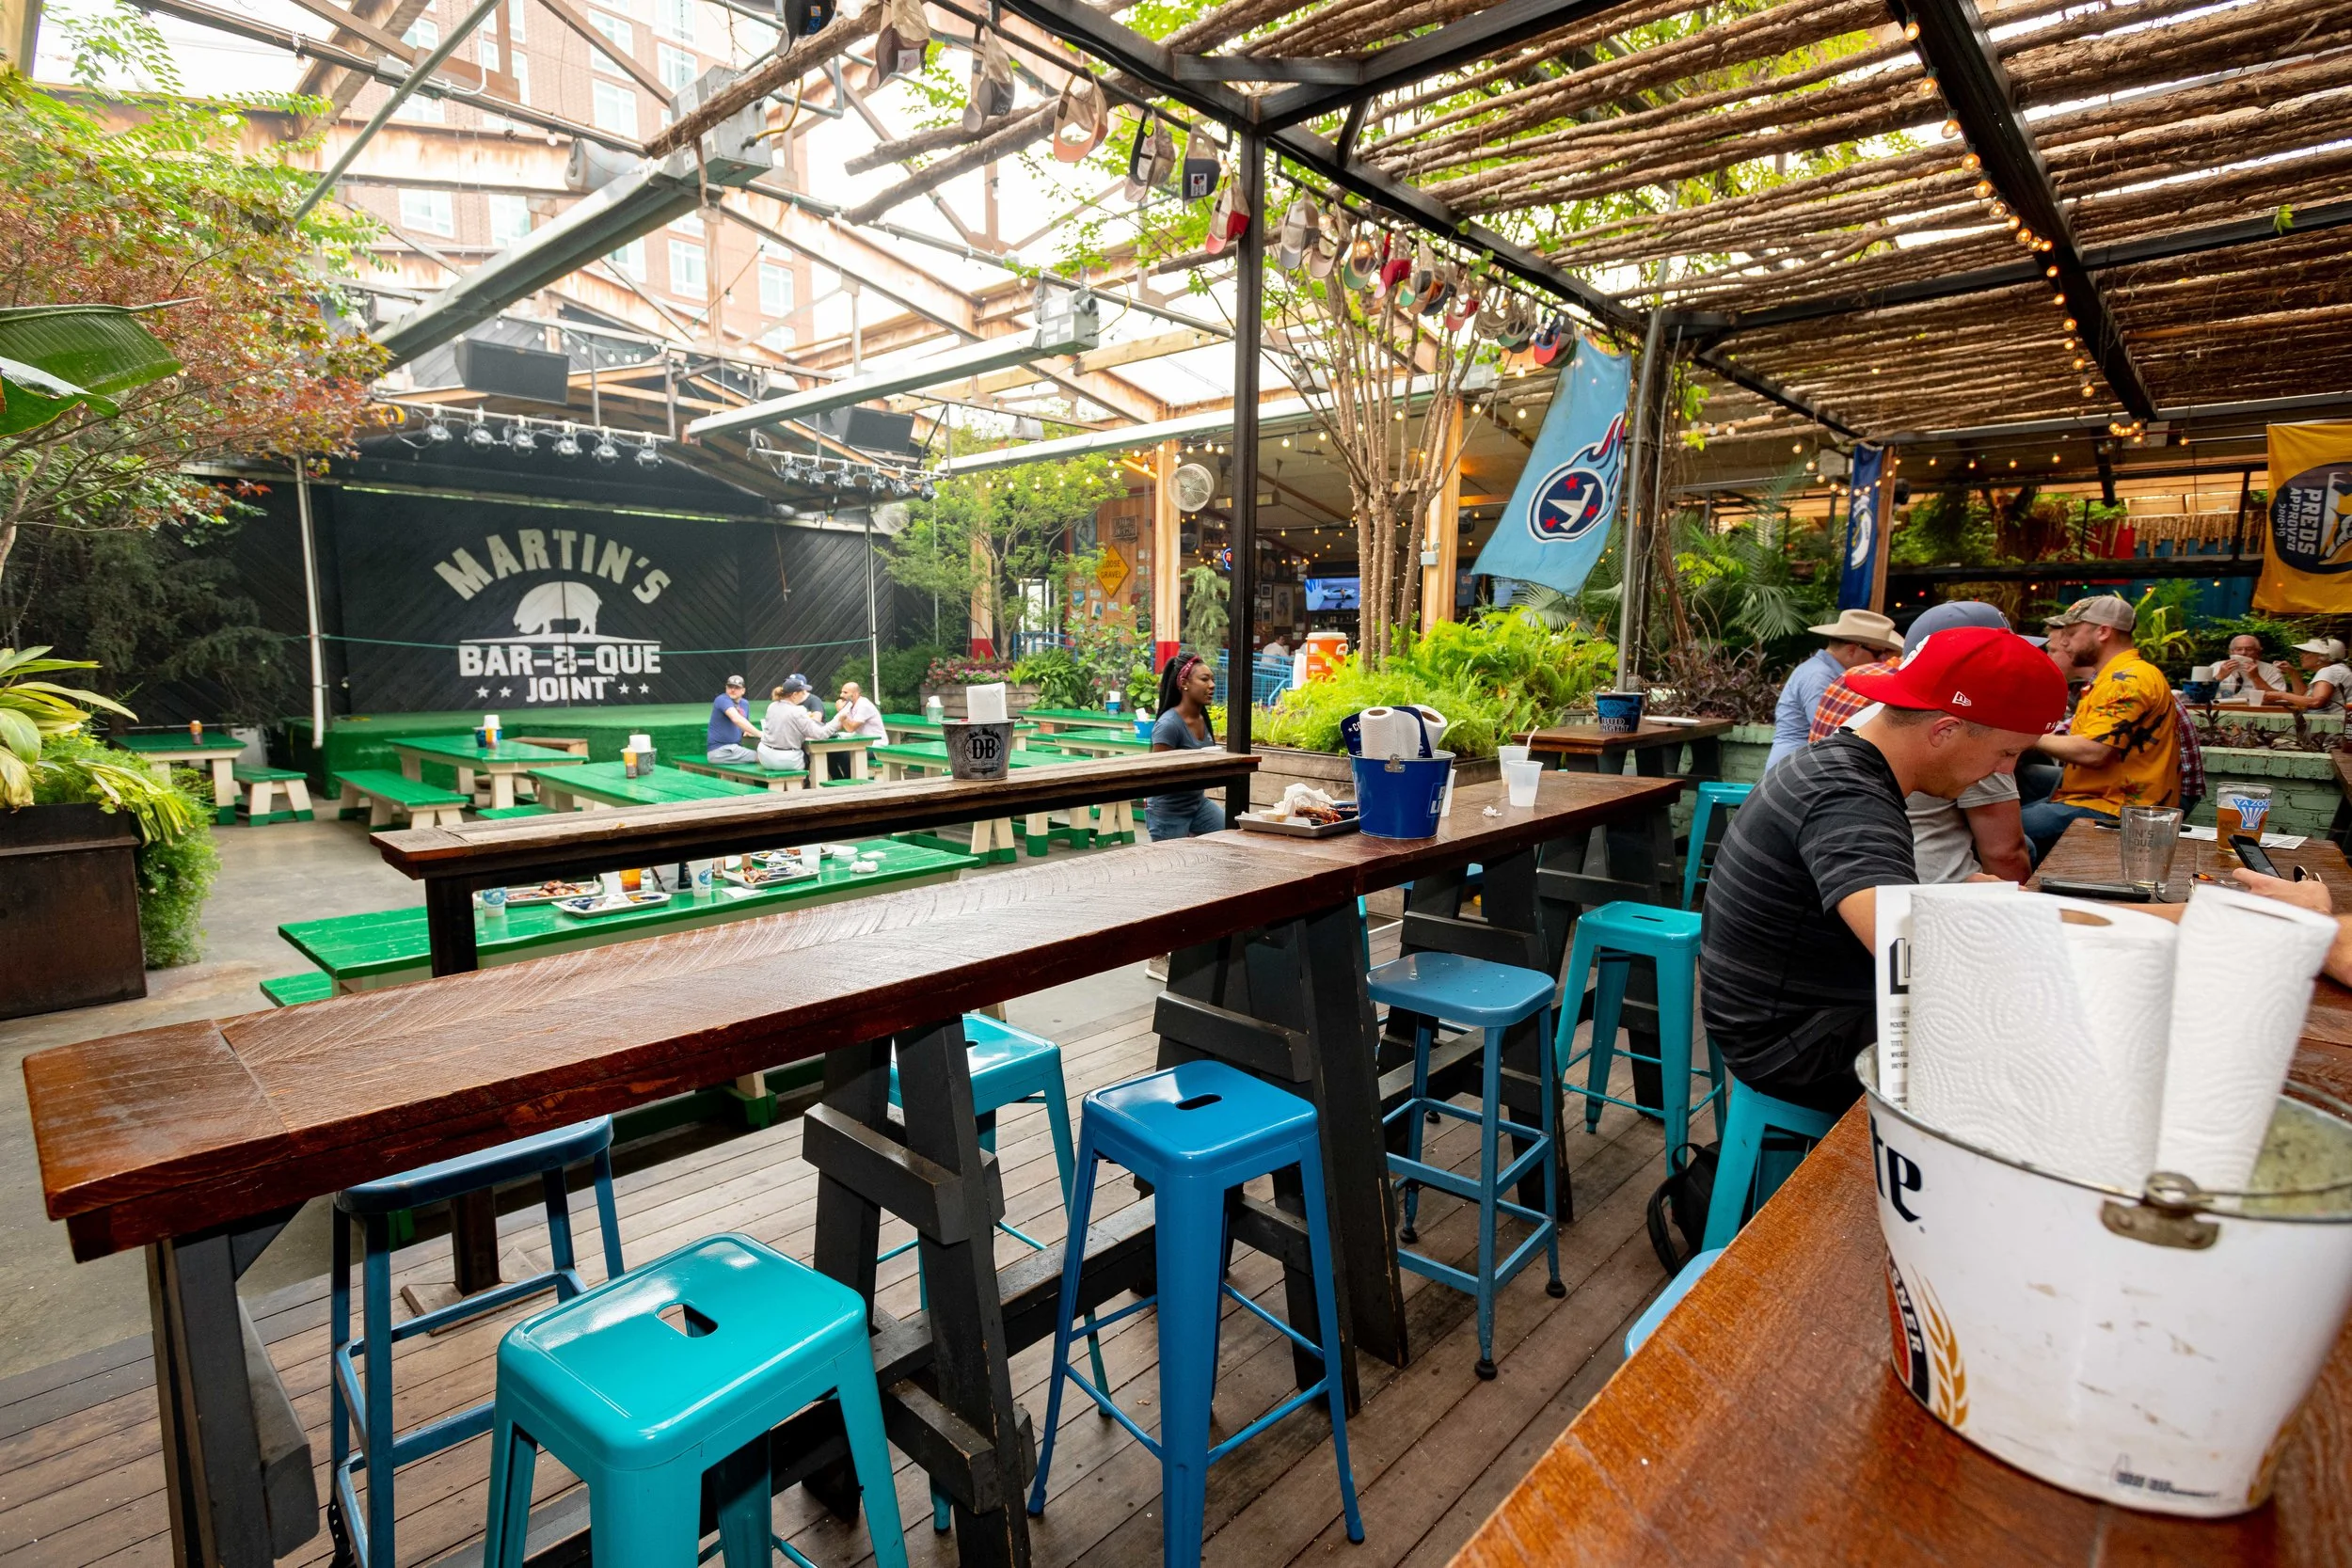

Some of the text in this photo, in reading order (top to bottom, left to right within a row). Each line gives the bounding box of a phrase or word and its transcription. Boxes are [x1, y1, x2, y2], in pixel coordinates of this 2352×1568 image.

[2286, 487, 2302, 551] APPROVED
[2297, 488, 2324, 555] PREDS
[433, 529, 672, 604] MARTIN'S
[458, 644, 661, 677] BAR-B-QUE
[526, 676, 608, 703] JOINT
[972, 738, 996, 759] DB
